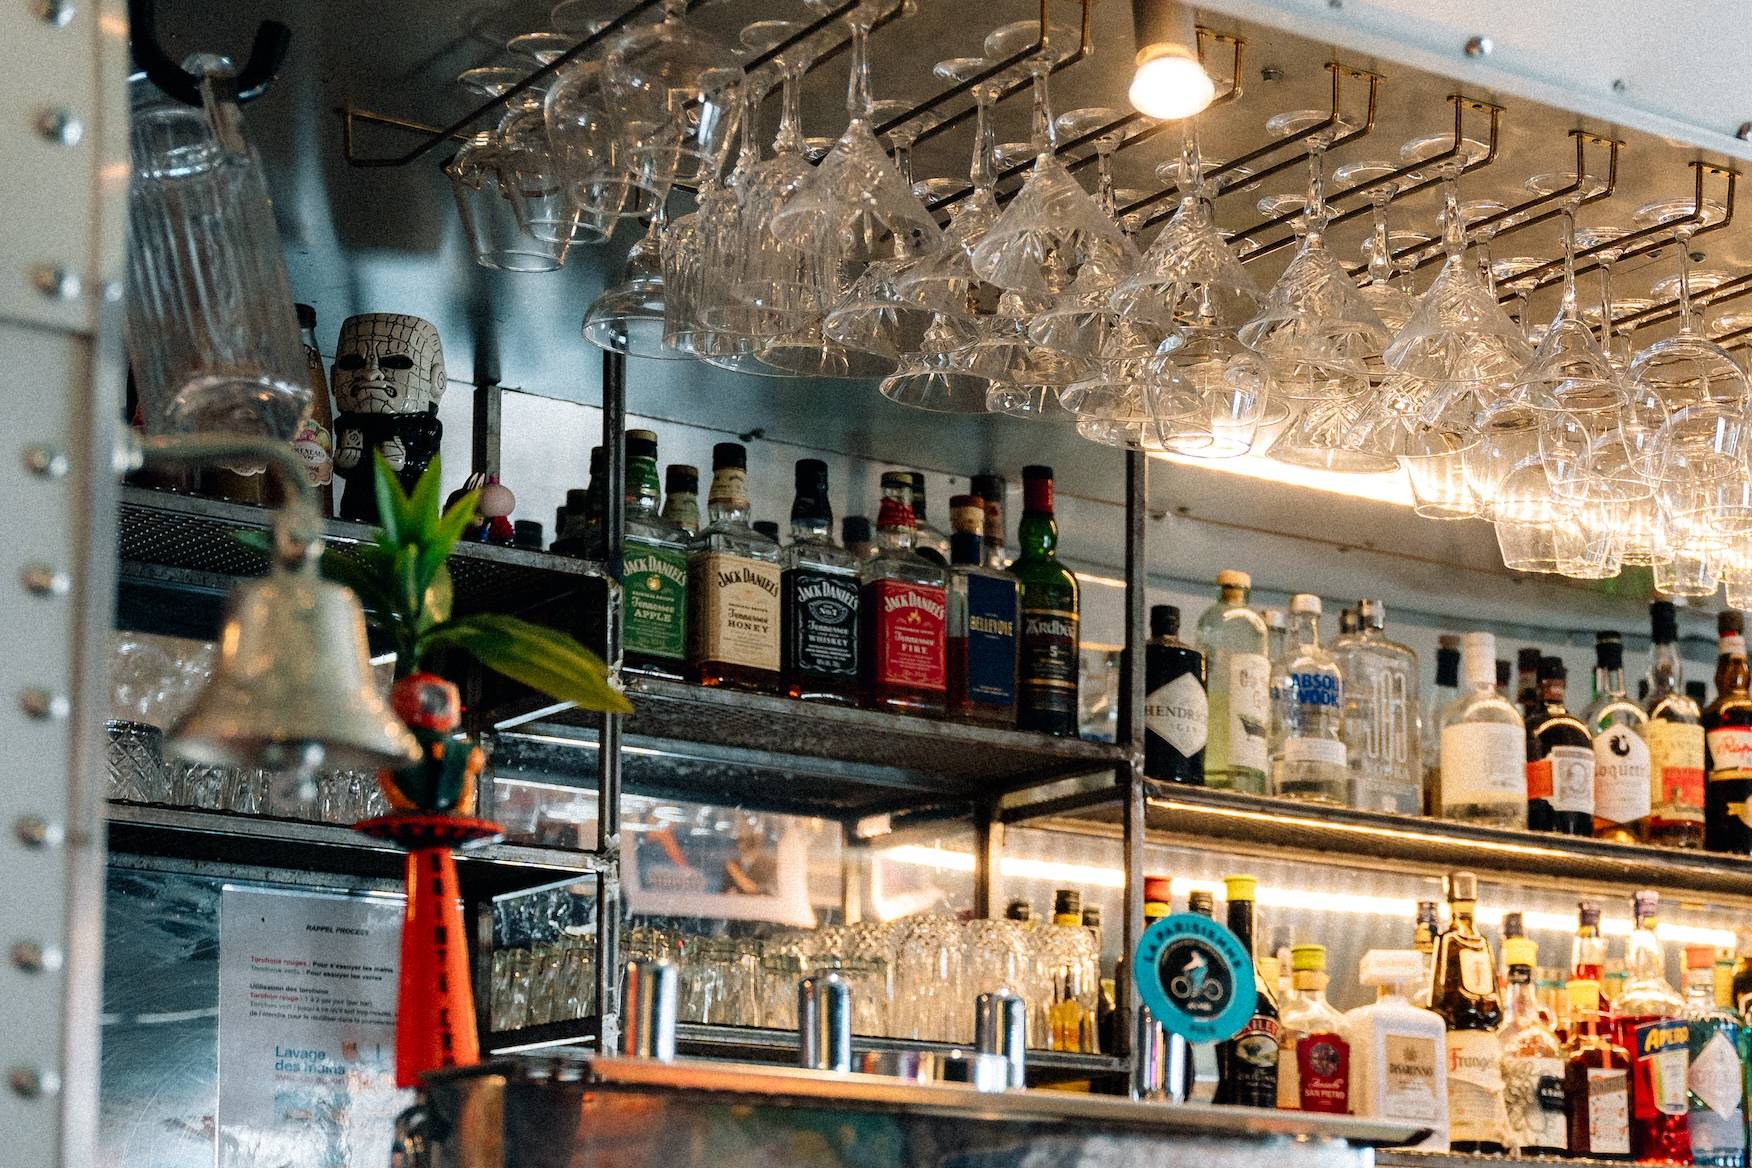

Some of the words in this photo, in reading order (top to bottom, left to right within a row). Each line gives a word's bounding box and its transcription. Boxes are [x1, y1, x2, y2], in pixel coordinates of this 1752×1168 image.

[623, 559, 647, 577] JACK
[649, 556, 687, 587] DANIEL'S
[718, 571, 742, 588] JACK
[743, 568, 779, 598] DANIEL'S
[797, 585, 822, 603] JACK
[822, 581, 859, 611] DANIEL'S
[631, 596, 675, 613] Tennessee
[884, 594, 908, 613] JACK
[908, 591, 945, 621] DANIEL'S
[633, 609, 672, 623] APPLE
[728, 608, 769, 623] Tennessee
[728, 621, 769, 634] HONEY
[807, 620, 849, 635] Tennessee
[807, 634, 849, 647] WHISKEY
[894, 631, 936, 646] Tennessee
[901, 643, 929, 655] FIRE
[306, 924, 333, 934] RAPPEL
[283, 958, 307, 967] rouges
[306, 969, 322, 977] Pour
[275, 1045, 327, 1063] Lavage
[275, 1060, 301, 1072] des
